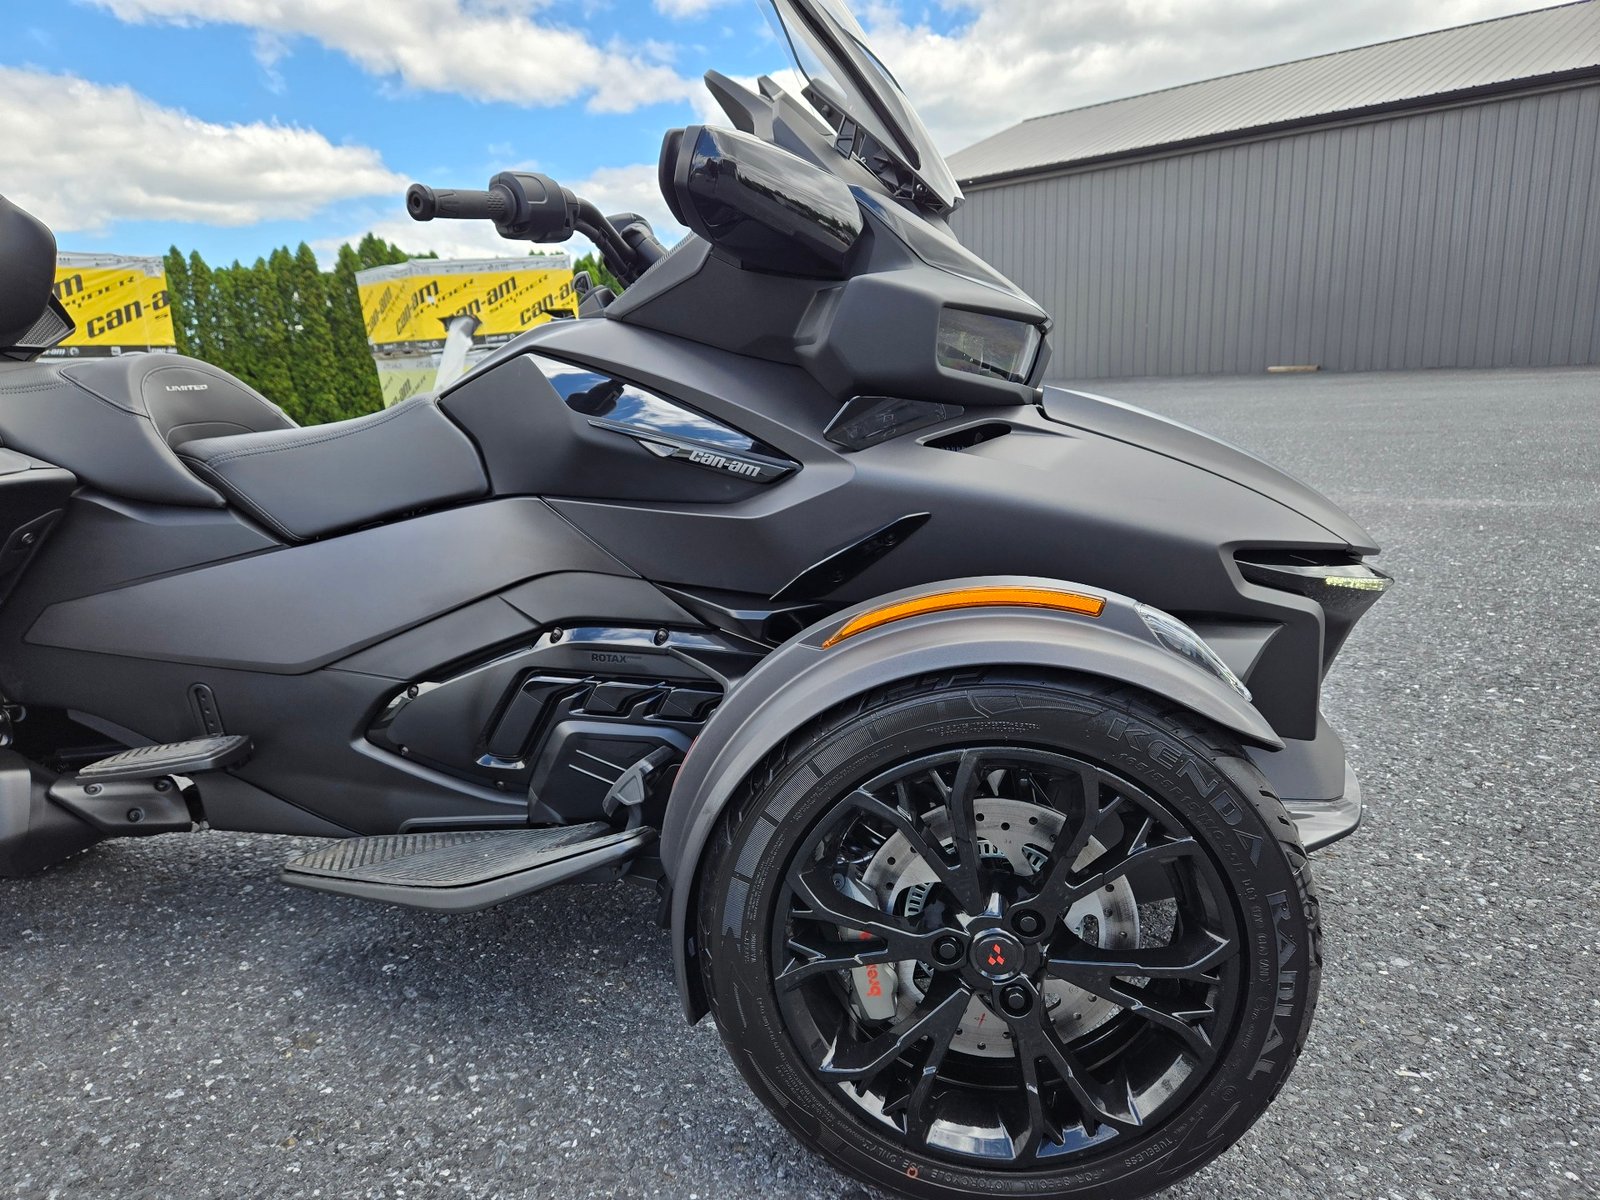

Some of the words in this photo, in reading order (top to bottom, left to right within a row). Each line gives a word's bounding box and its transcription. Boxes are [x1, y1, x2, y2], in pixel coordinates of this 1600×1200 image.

[87, 289, 171, 338] can-a
[456, 276, 517, 316] an-am
[520, 279, 574, 326] can-a
[689, 450, 760, 477] can-am
[591, 653, 627, 663] ROTAX
[1106, 716, 1263, 868] KENDA
[1246, 889, 1298, 1081] RADIAL
[1123, 1136, 1174, 1168] TUBELESS
